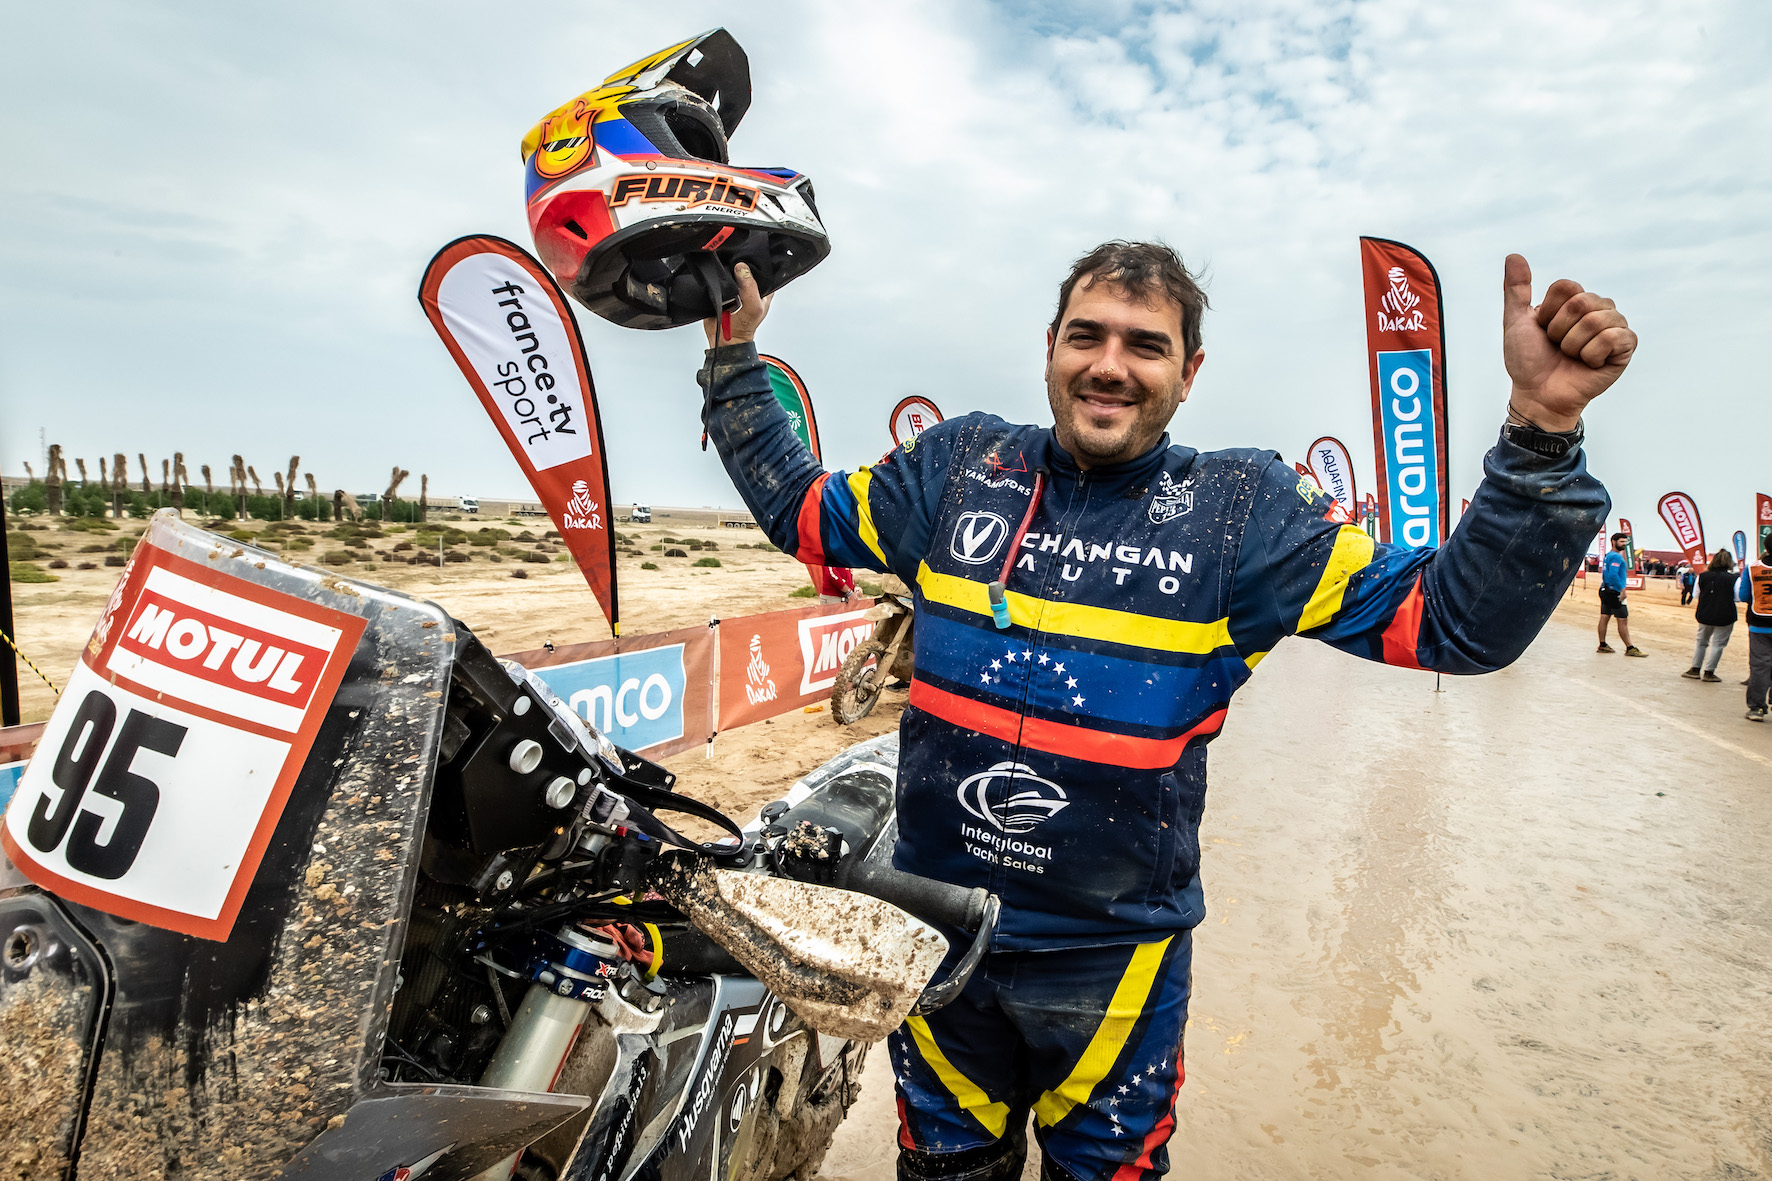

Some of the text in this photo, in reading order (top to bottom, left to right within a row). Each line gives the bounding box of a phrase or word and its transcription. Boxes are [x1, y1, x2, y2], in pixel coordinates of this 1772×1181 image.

[705, 205, 748, 217] ENERGY
[1377, 310, 1428, 333] DAKAR
[493, 361, 552, 446] sport
[1318, 449, 1347, 504] AQUAFINA
[1390, 366, 1431, 549] aramco
[964, 468, 1032, 497] YAMAMOTORS
[563, 512, 603, 531] DAKAR
[1667, 501, 1696, 543] MOTUL
[1020, 532, 1194, 574] CHANGAN
[127, 602, 303, 695] MOTUL
[745, 679, 778, 706] DAKAR
[27, 690, 189, 880] 95
[961, 823, 1052, 860] Interglobal
[965, 841, 1044, 874] Yacht Sales
[679, 1013, 733, 1153] Husqvarna
